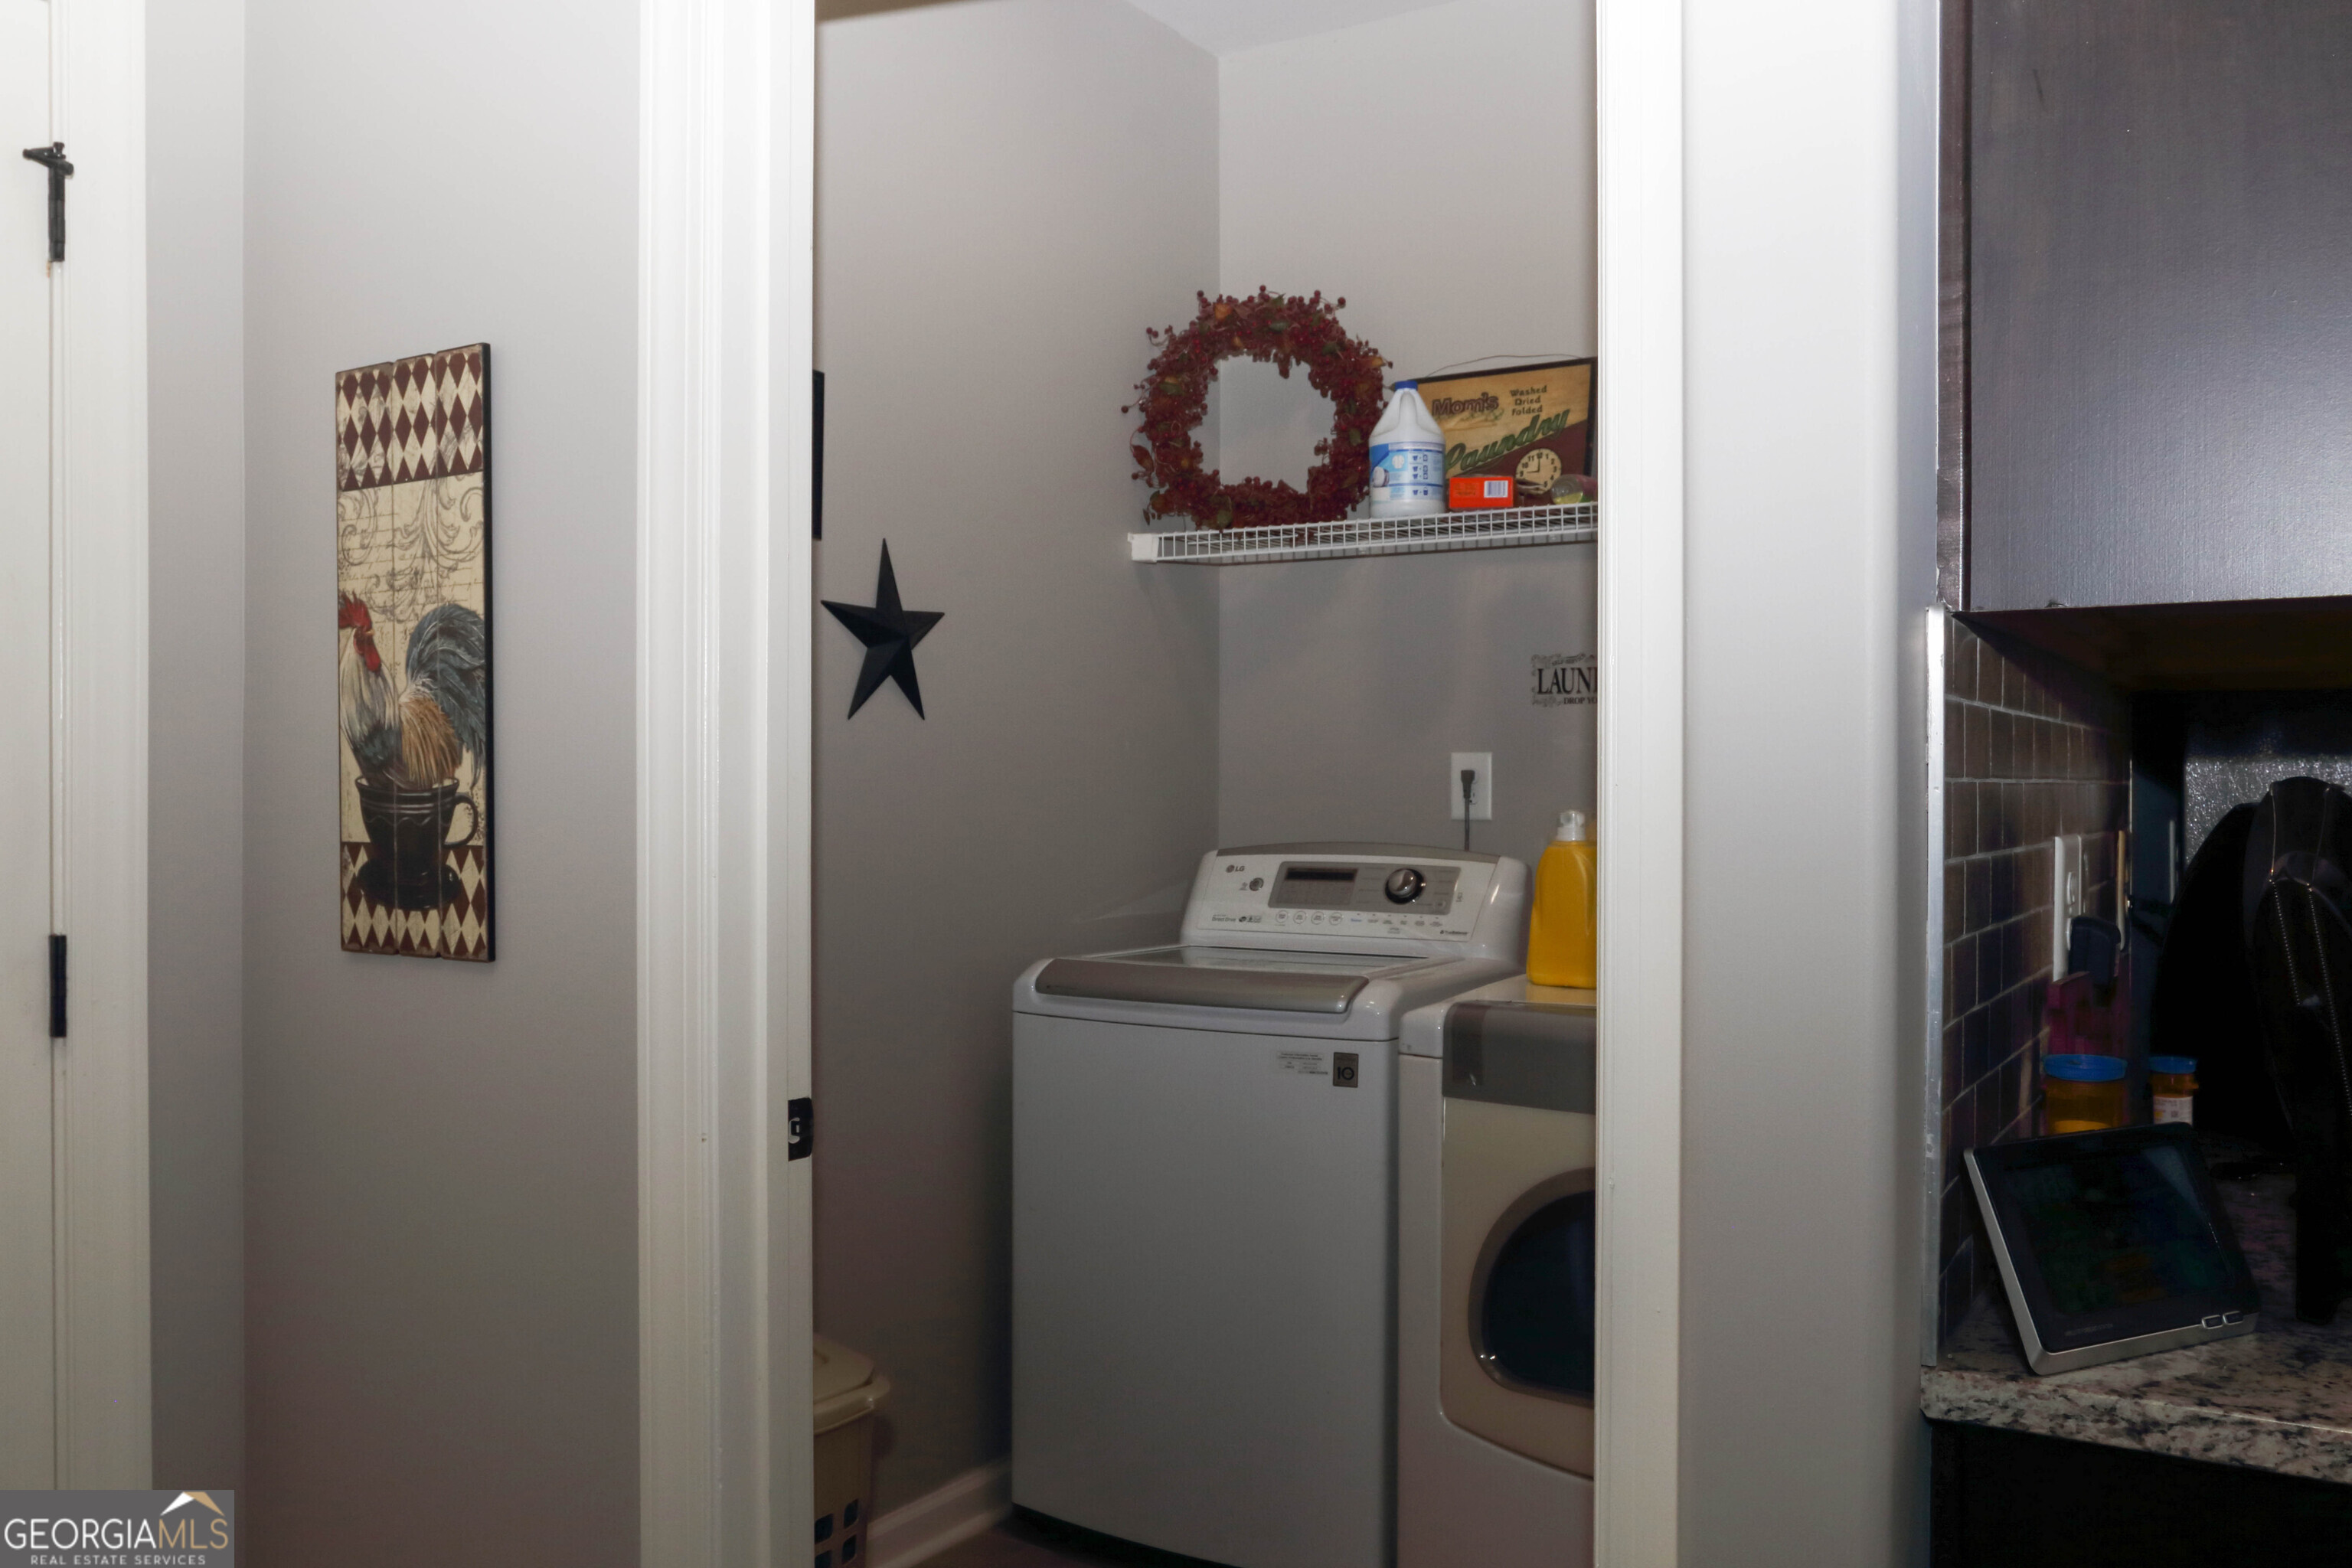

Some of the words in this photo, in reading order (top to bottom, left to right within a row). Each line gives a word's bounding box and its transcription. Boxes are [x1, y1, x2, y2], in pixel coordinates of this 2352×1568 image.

[1510, 385, 1547, 397] Washed
[1432, 391, 1499, 416] Mom's
[1514, 396, 1541, 407] Dried
[1512, 405, 1543, 416] Folded
